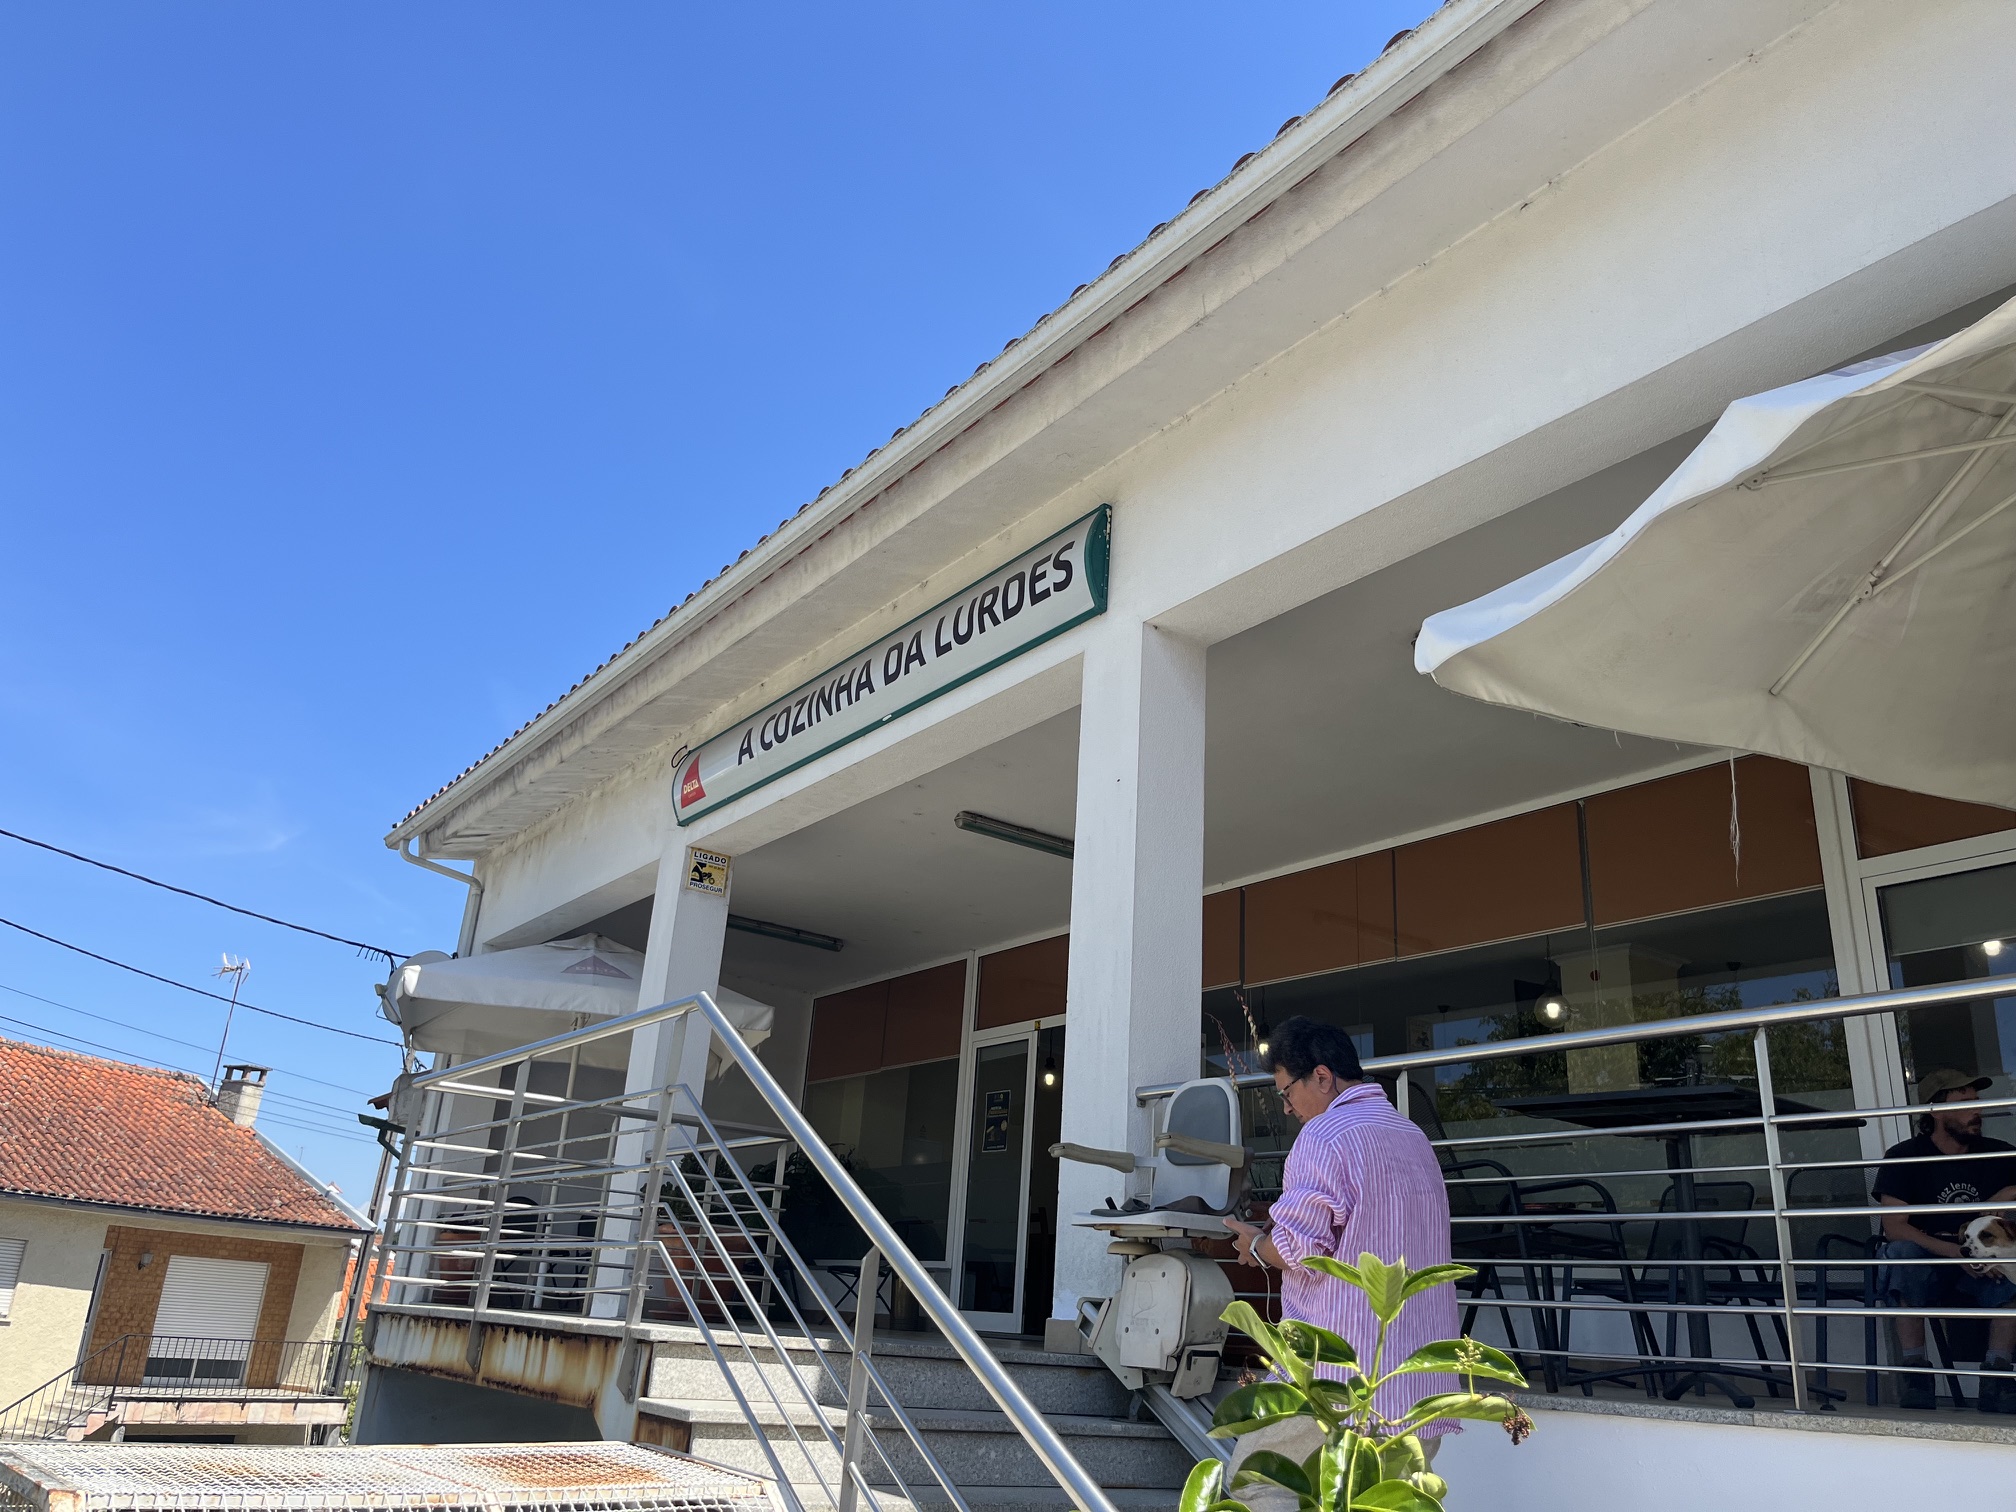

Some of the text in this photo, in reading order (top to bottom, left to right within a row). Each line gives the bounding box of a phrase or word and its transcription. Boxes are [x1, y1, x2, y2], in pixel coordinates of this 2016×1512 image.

[738, 541, 1076, 766] A COZINHA DA LURDES
[683, 778, 700, 795] DELTA
[693, 851, 727, 864] LIGADO
[689, 881, 723, 894] PROSEGUR
